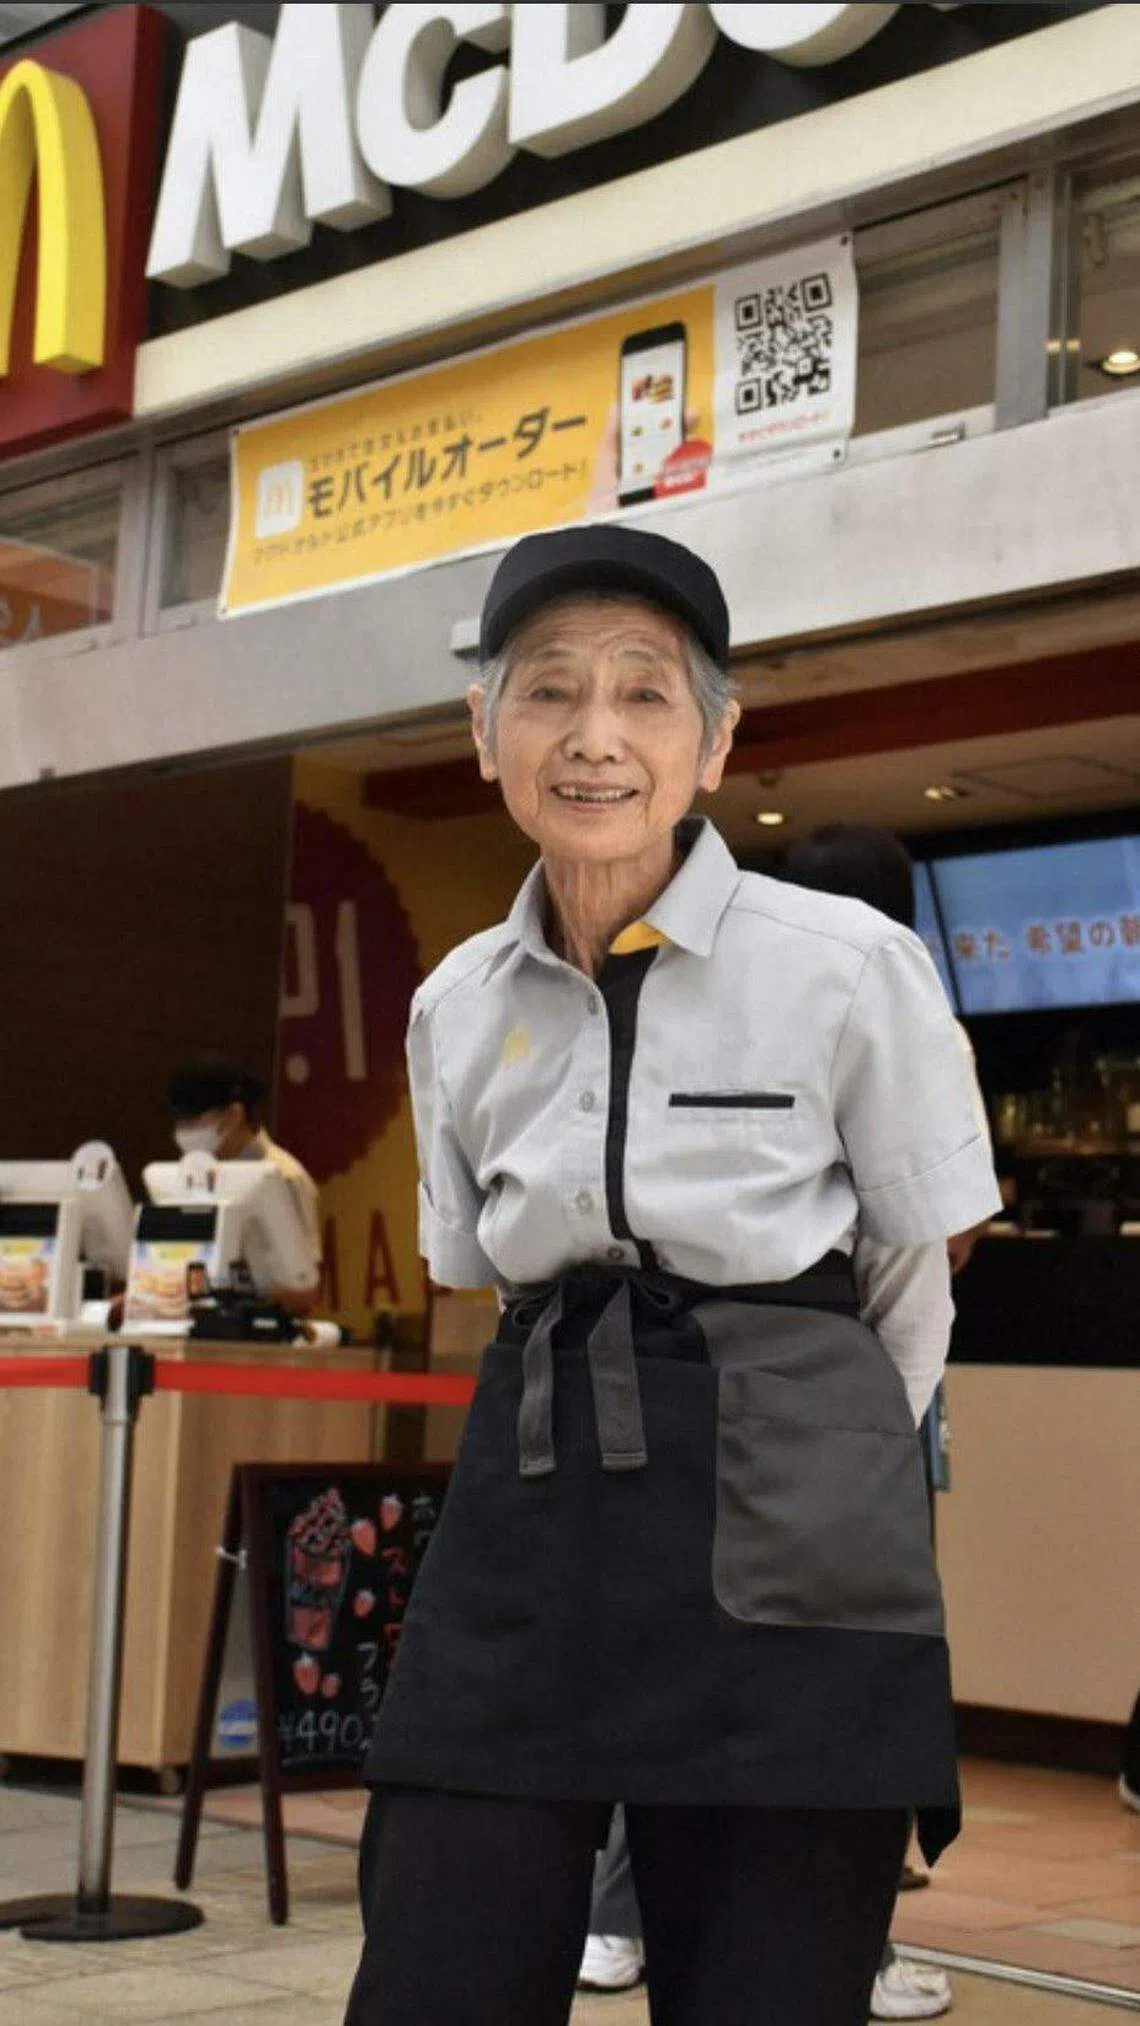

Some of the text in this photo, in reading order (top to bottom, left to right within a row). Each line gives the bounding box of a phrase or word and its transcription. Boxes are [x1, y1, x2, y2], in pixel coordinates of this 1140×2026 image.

[145, 4, 898, 285] McD
[307, 407, 588, 519] モバイルオーダー
